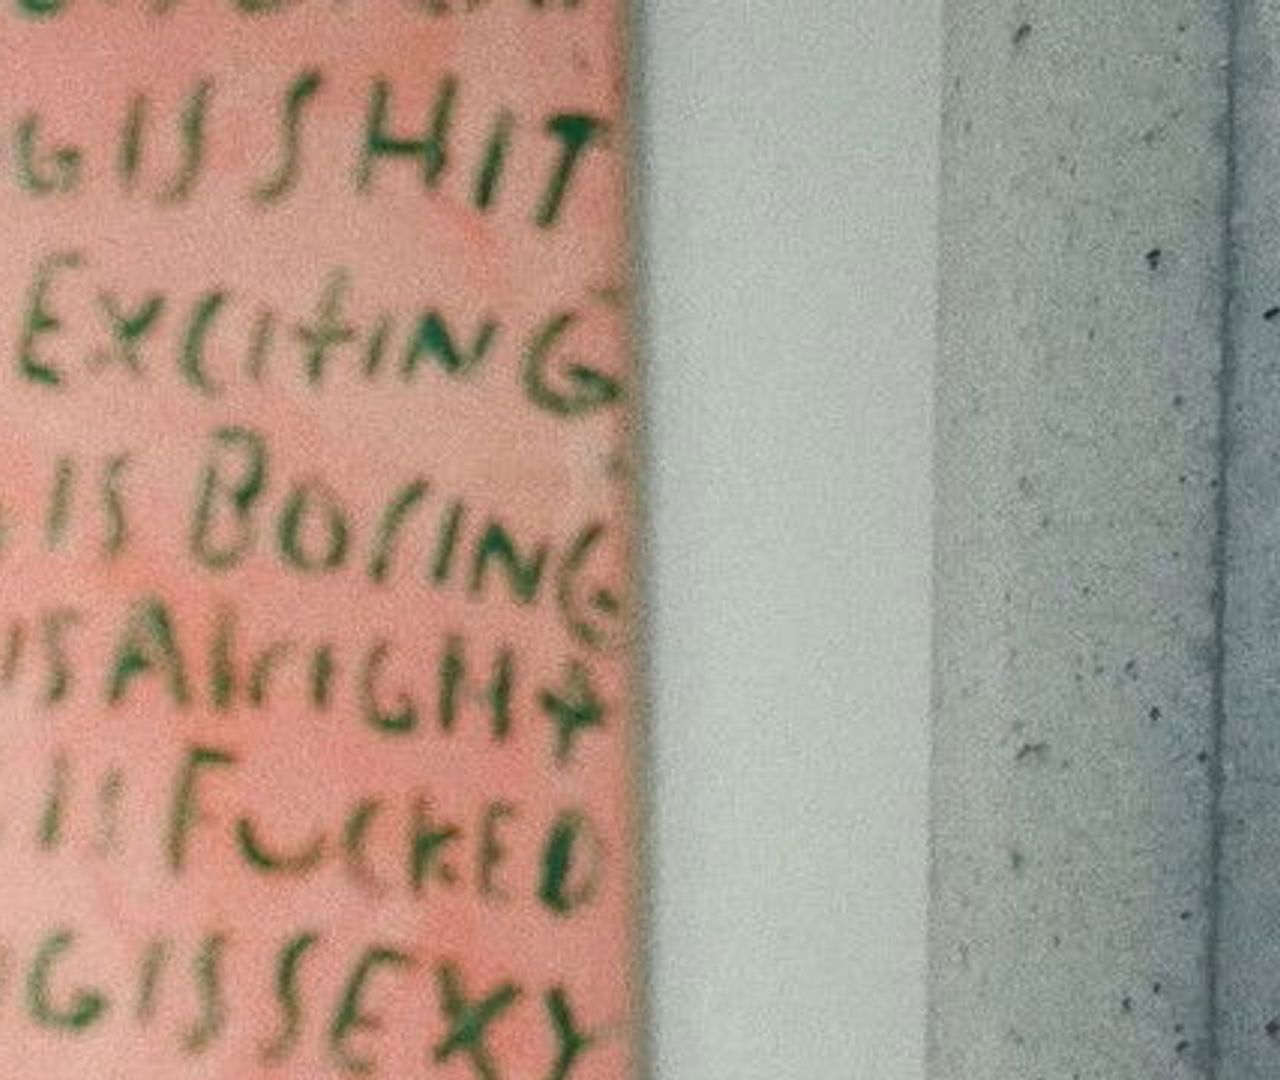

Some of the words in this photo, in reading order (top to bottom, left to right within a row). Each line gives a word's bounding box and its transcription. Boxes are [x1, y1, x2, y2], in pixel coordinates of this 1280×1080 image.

[120, 78, 214, 203] IS
[253, 70, 610, 228] SHIT
[46, 450, 130, 558] IS
[3, 606, 80, 704] IS
[168, 746, 605, 917] FUCKED
[136, 930, 226, 1054] IS
